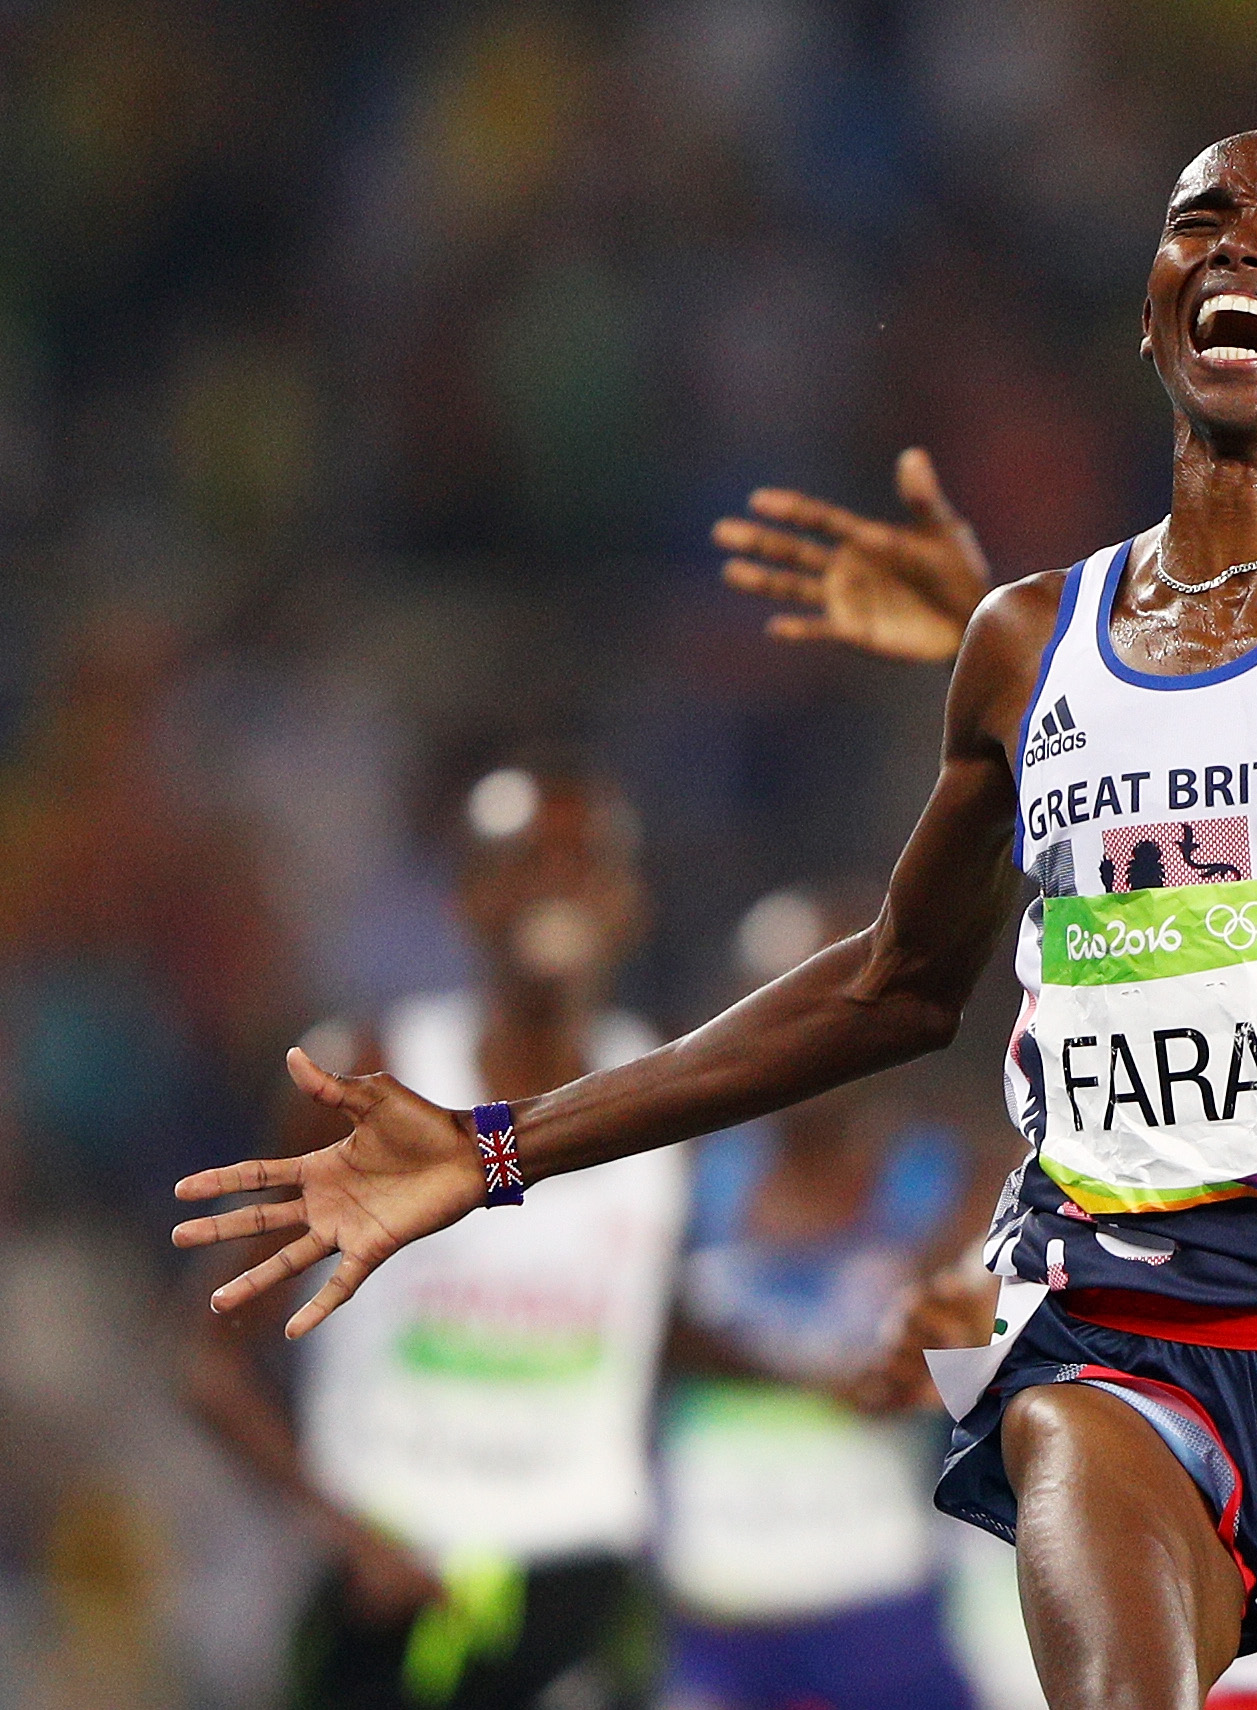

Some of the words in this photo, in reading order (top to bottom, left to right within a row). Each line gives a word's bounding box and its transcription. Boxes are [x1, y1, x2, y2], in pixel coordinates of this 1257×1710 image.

[1025, 731, 1087, 768] adidas
[1028, 771, 1151, 841] GREAT
[1065, 914, 1183, 961] Rio2016
